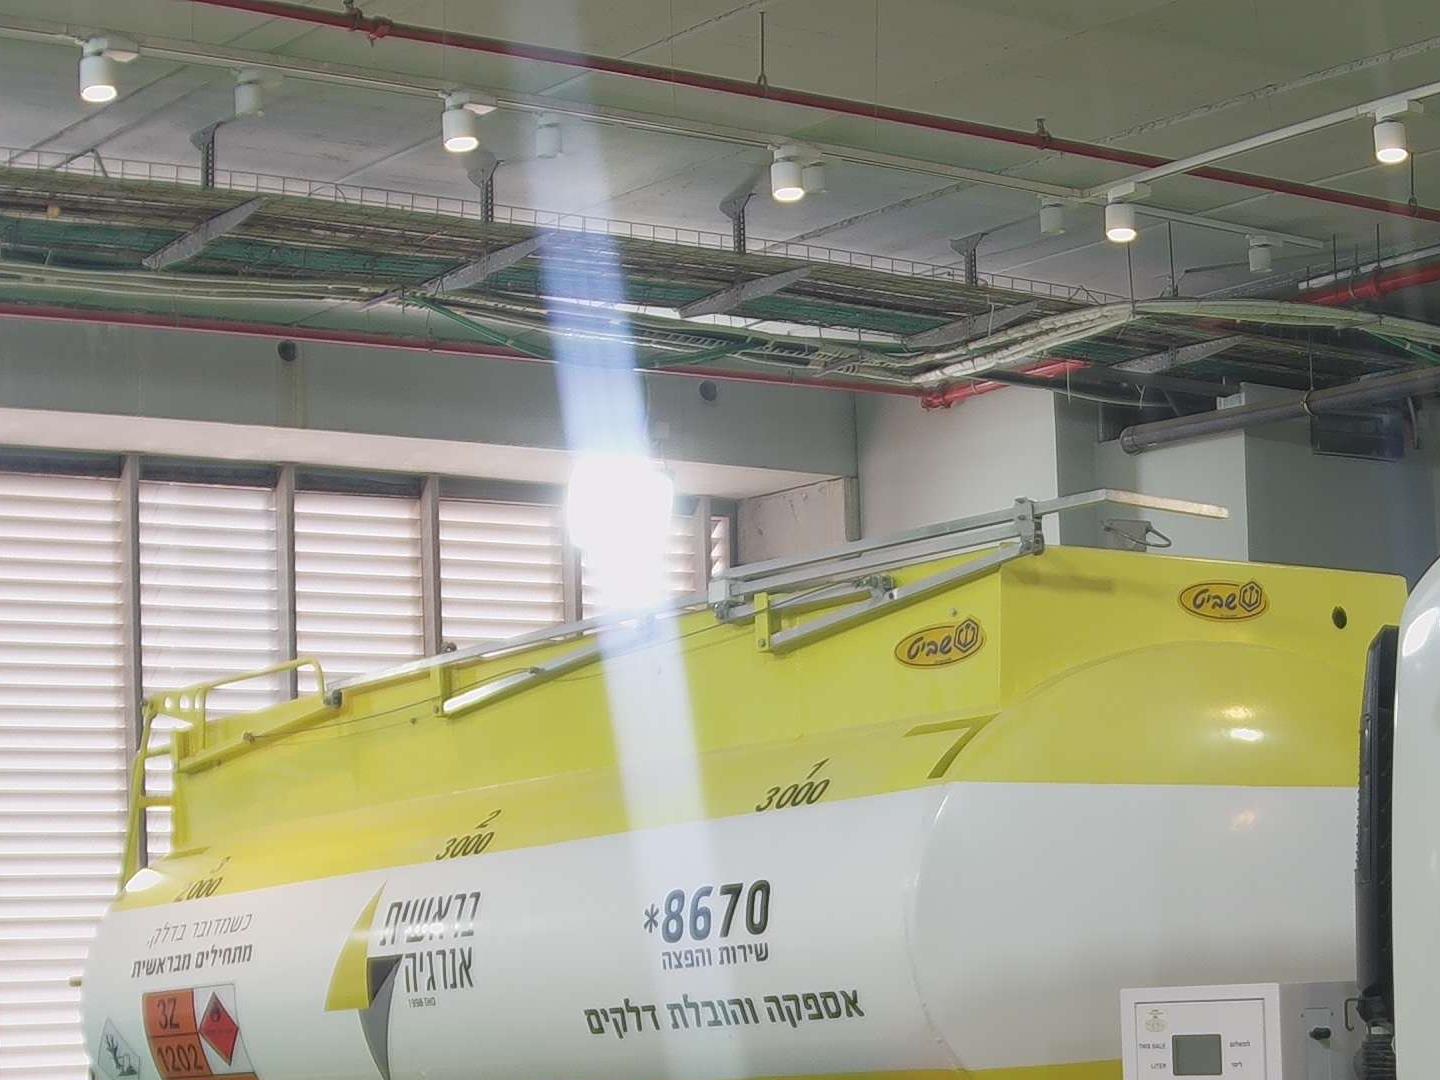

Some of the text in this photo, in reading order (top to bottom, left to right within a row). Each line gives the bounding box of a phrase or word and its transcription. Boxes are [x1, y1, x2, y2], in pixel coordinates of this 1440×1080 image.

[755, 779, 830, 812] 3000
[435, 831, 495, 861] 3000
[192, 913, 253, 939] כשמדובר
[131, 943, 253, 978] מתחילים מבראשית
[404, 946, 474, 993] אנרגיה
[661, 942, 769, 970] שירות והפצה
[583, 989, 865, 1040] אספקה והובלת דלקים
[157, 1044, 204, 1073] 1202
